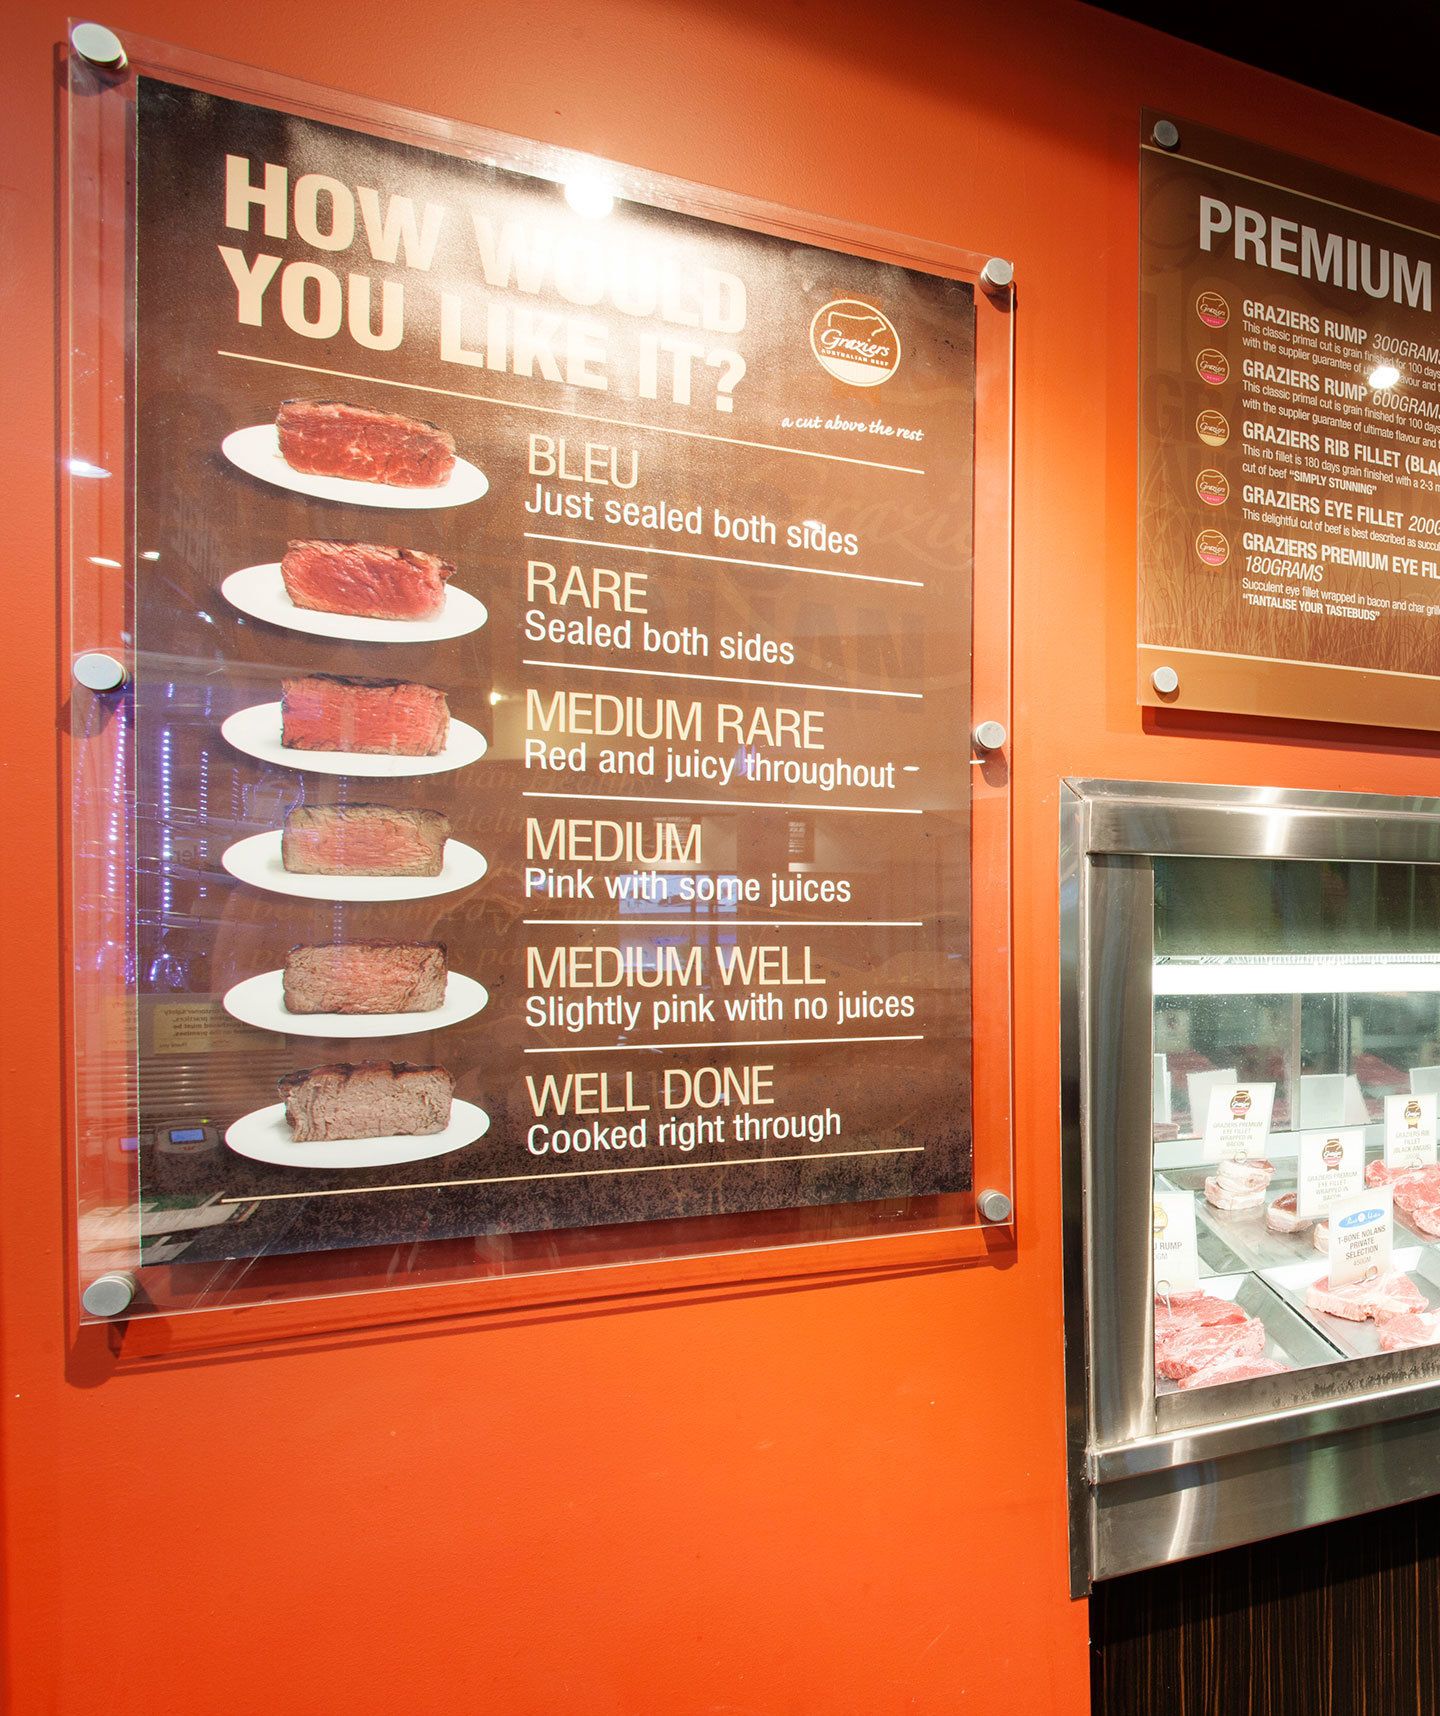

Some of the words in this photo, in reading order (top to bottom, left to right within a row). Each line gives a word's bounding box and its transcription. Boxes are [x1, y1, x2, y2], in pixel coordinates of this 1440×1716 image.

[225, 154, 444, 272] HOW
[1200, 195, 1432, 313] PREMIUM
[217, 245, 404, 352] YOU
[440, 287, 610, 389] LIKE
[638, 329, 747, 413] IT?
[821, 329, 890, 357] Graziers
[1242, 300, 1319, 335] GRAZIERS
[1324, 320, 1366, 347] RUMP
[1242, 360, 1319, 393] GRAZIERS
[1324, 378, 1367, 403] RUMP
[781, 418, 794, 428] a
[795, 416, 822, 429] cut
[825, 415, 867, 433] above
[869, 419, 895, 436] the
[896, 427, 925, 441] rest
[1242, 421, 1319, 453] GRAZIERS
[1324, 438, 1348, 459] RIB
[1354, 444, 1400, 469] FILLET
[527, 436, 639, 489] BLEU
[525, 486, 593, 521] Just
[603, 496, 701, 535] sealed
[712, 510, 776, 545] both
[787, 520, 858, 556] sides
[1242, 486, 1319, 515] GRAZIERS
[1324, 500, 1352, 521] EYE
[1357, 506, 1403, 529] FILLET
[1242, 533, 1316, 561] GRAZIERS
[1321, 546, 1388, 572] PREMIUM
[1392, 557, 1418, 576] EYE
[1246, 556, 1323, 582] 180GRAMS
[526, 561, 648, 614] RARE
[525, 611, 630, 650] Sealed
[640, 621, 707, 657] both
[718, 629, 794, 665] sides
[527, 689, 701, 742] MEDIUM
[713, 702, 824, 749] RARE
[525, 739, 586, 772] Red
[598, 743, 653, 776] and
[664, 747, 734, 786] juicy
[743, 752, 896, 794] throughout
[527, 819, 701, 862] MEDIUM
[525, 869, 593, 898] Pink
[603, 871, 671, 900] with
[681, 878, 759, 901] some
[768, 875, 851, 908] juices
[527, 946, 704, 988] MEDIUM
[715, 946, 825, 985] WELL
[525, 996, 642, 1032] Slightly
[653, 995, 714, 1031] pink
[722, 994, 782, 1022] with
[794, 999, 826, 1020] no
[838, 992, 914, 1026] juices
[526, 1070, 649, 1116] WELL
[658, 1066, 774, 1109] DONE
[527, 1119, 645, 1155] Cooked
[655, 1115, 724, 1154] right
[732, 1109, 841, 1149] through
[1345, 1244, 1379, 1260] SELECTION
